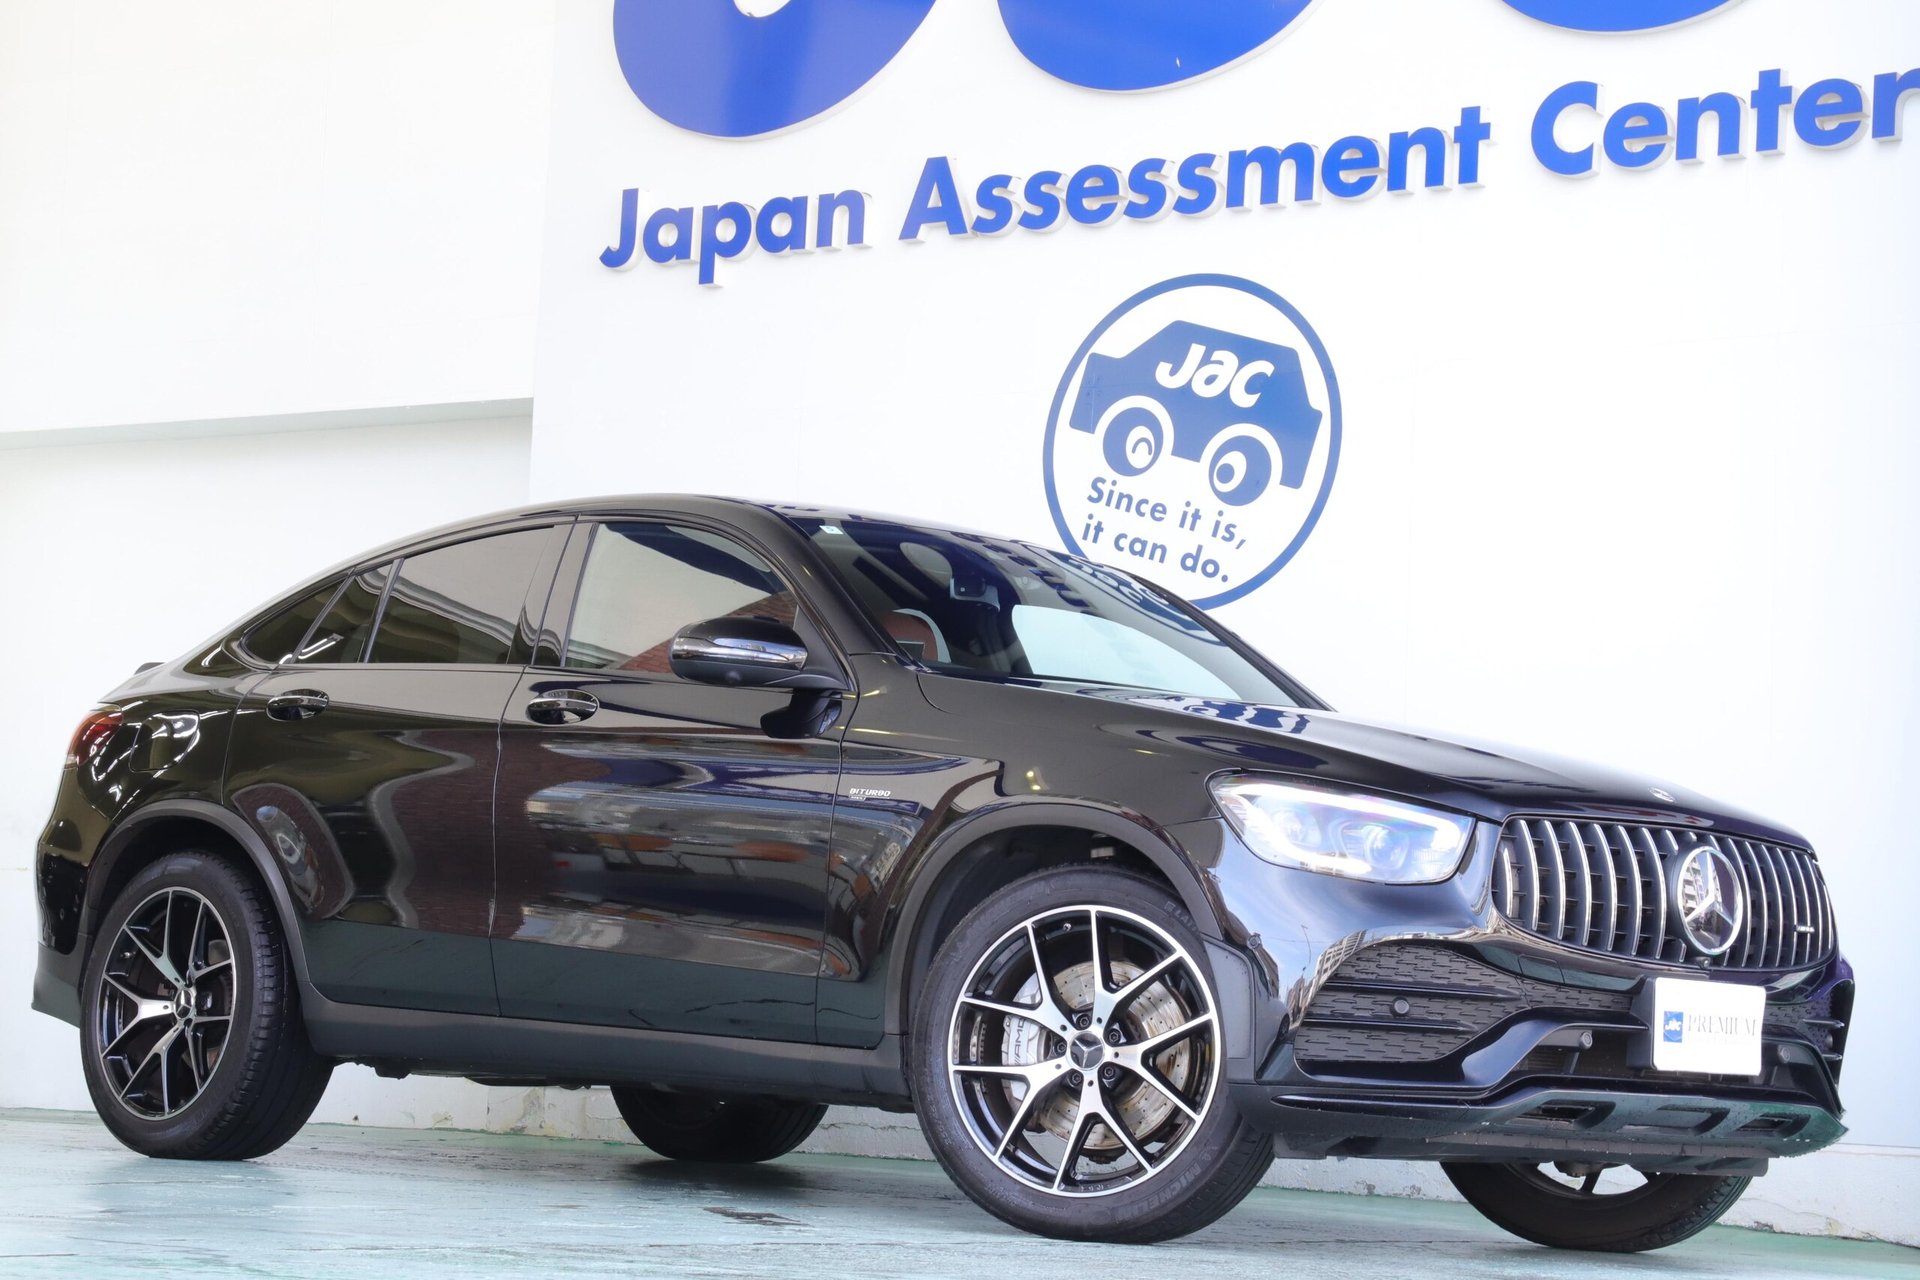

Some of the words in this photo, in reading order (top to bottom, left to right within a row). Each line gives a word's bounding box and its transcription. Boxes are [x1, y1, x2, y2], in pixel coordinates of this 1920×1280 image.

[600, 188, 868, 285] Japan
[899, 106, 1491, 239] Assessment
[1531, 68, 1920, 176] Center
[1082, 513, 1104, 544] it
[1113, 532, 1168, 564] can
[1180, 544, 1229, 583] do.
[1086, 476, 1167, 522] Since
[1178, 501, 1202, 531] it
[1211, 510, 1246, 550] is,
